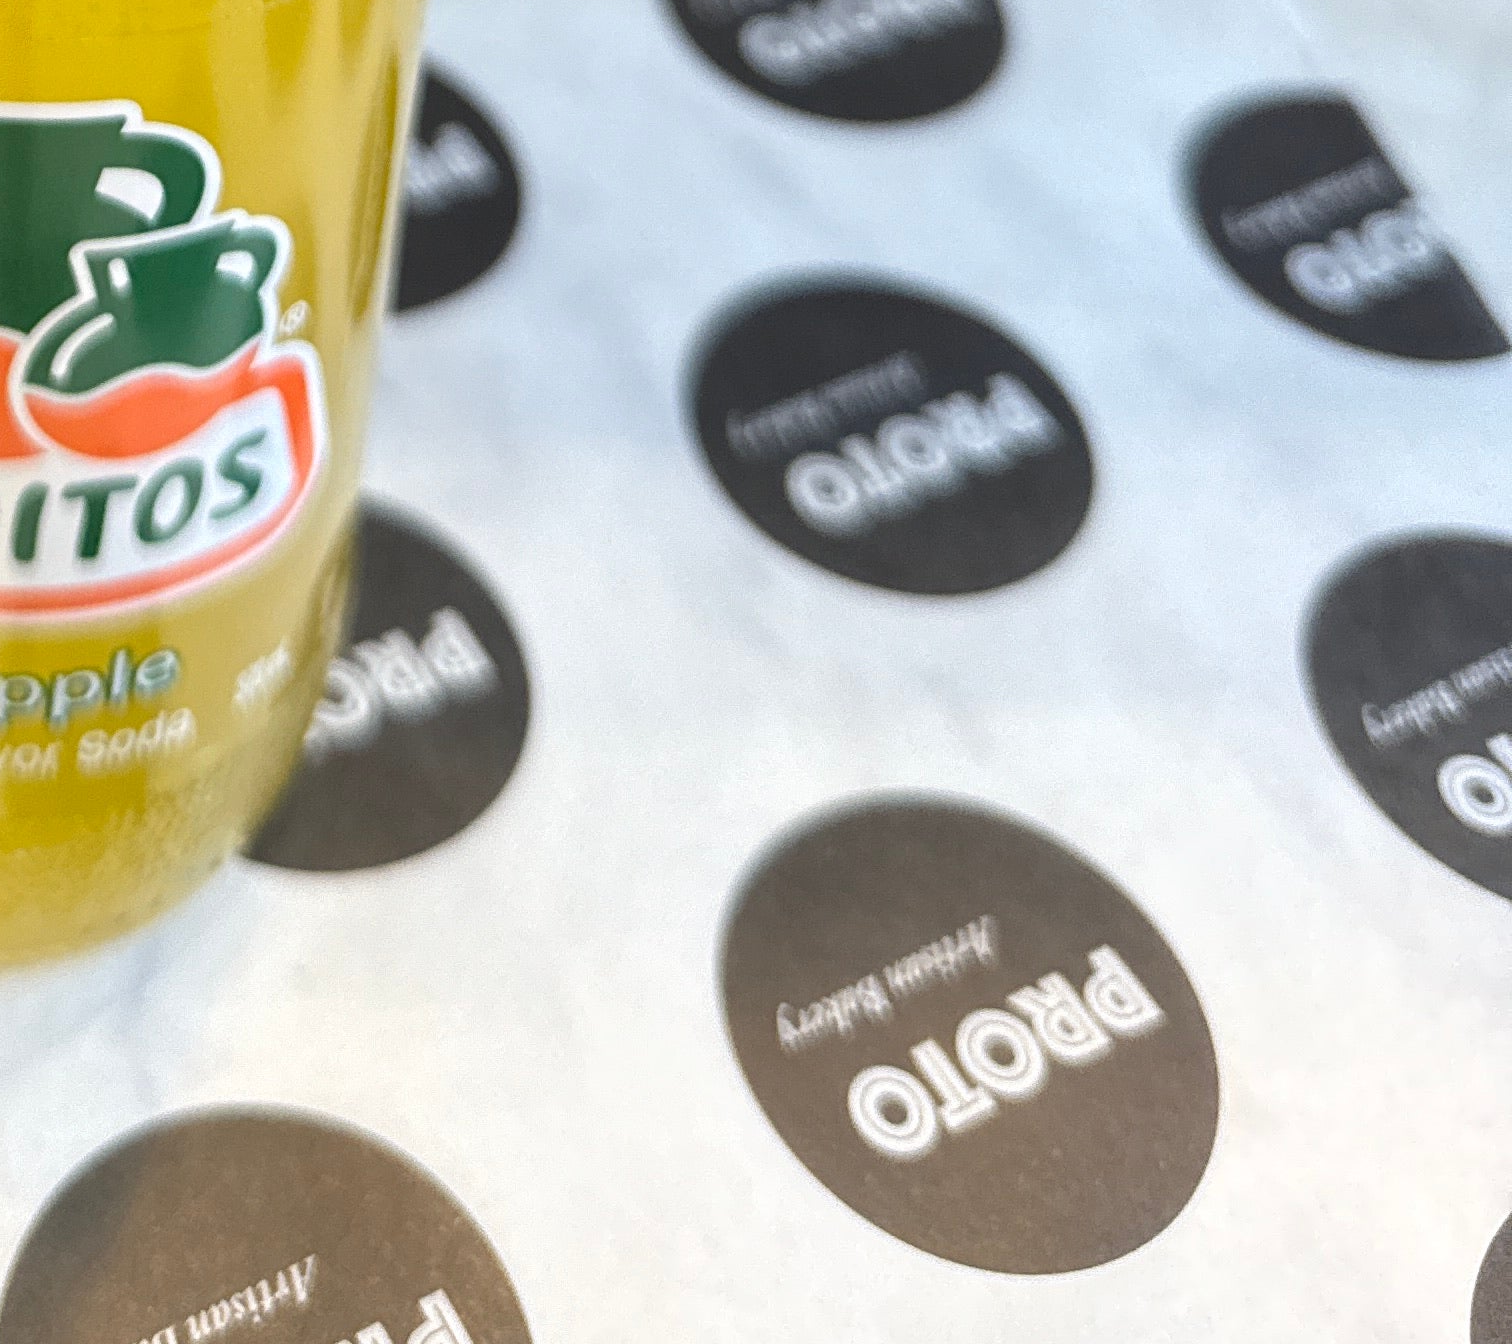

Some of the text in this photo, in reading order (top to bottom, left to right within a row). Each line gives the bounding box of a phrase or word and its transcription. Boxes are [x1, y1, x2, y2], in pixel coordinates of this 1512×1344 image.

[77, 707, 199, 772] Soda
[846, 943, 1166, 1160] PROTO
[185, 1252, 318, 1343] Artisan
